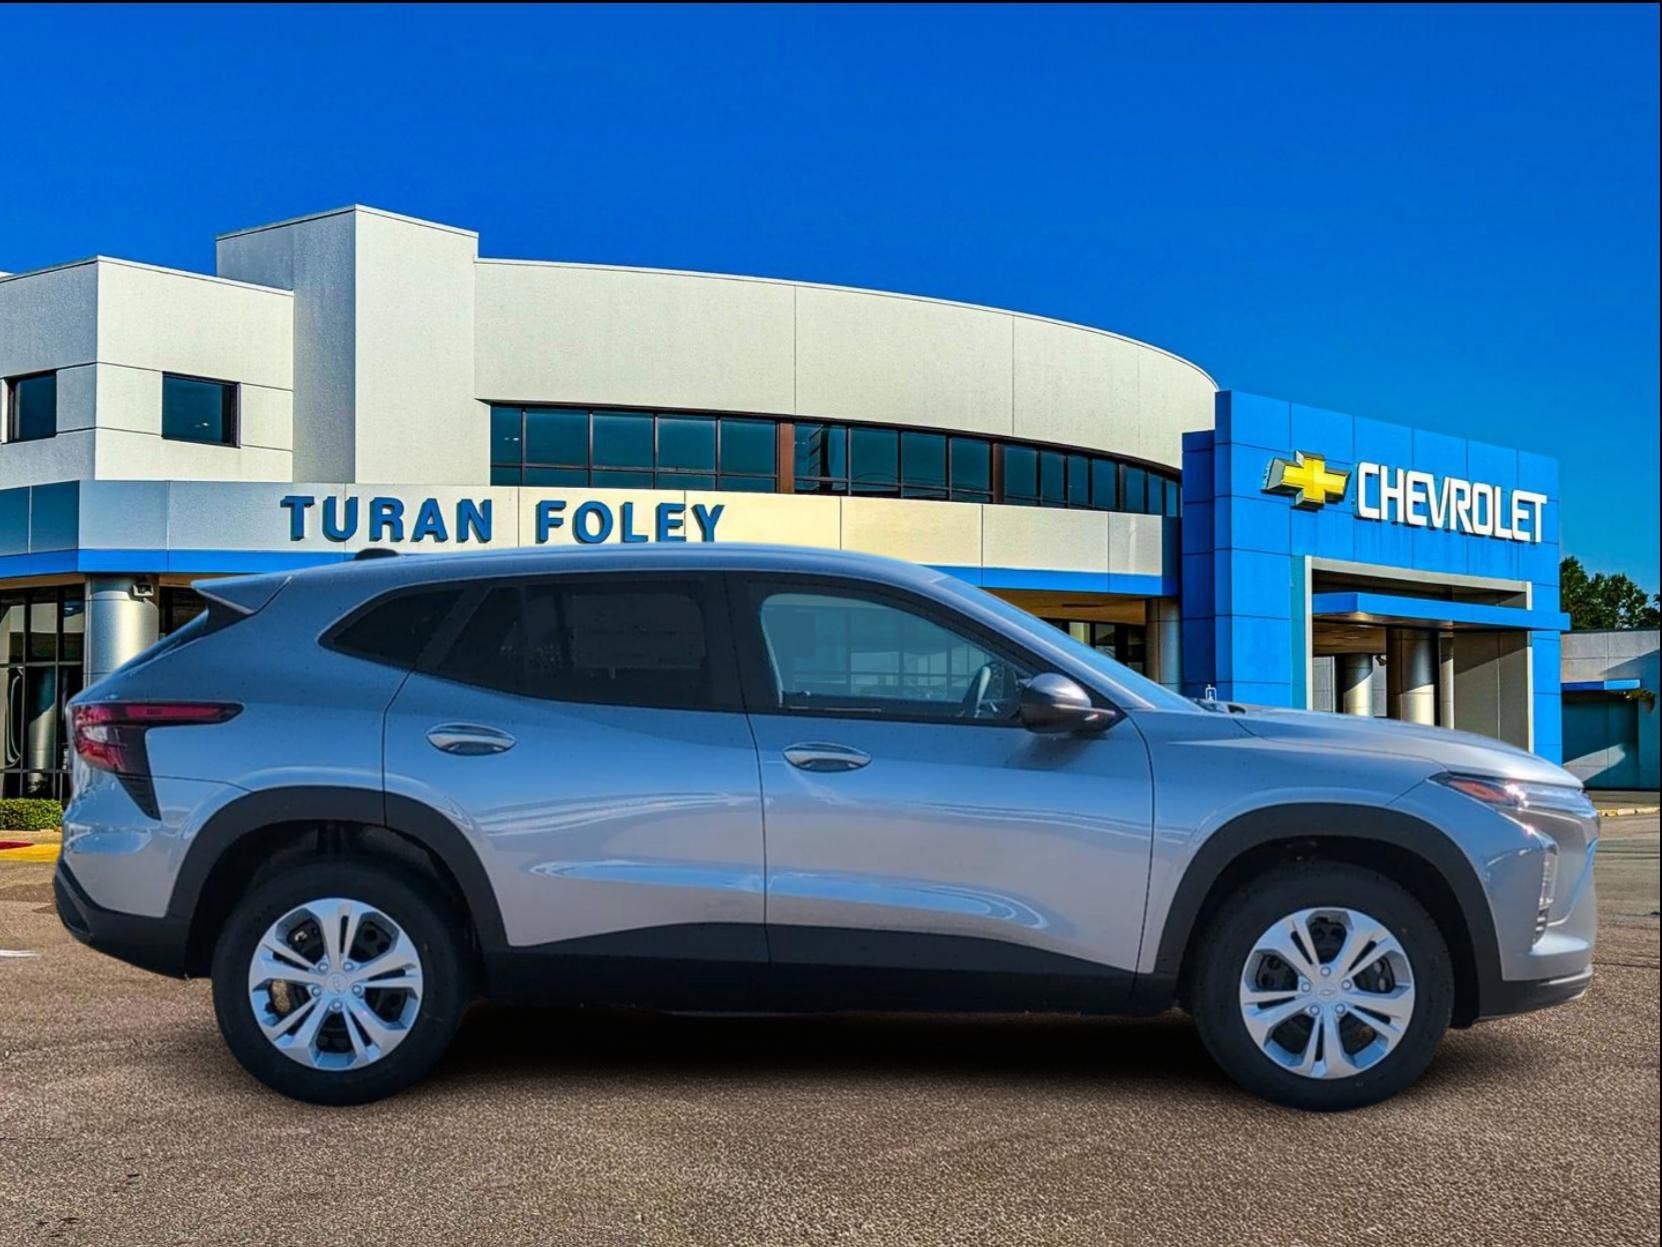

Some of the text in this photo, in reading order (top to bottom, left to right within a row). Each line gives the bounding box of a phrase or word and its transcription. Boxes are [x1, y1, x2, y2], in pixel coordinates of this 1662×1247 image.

[280, 495, 726, 544] TURAN FOLEY
[1357, 461, 1548, 543] CHEVROLET
